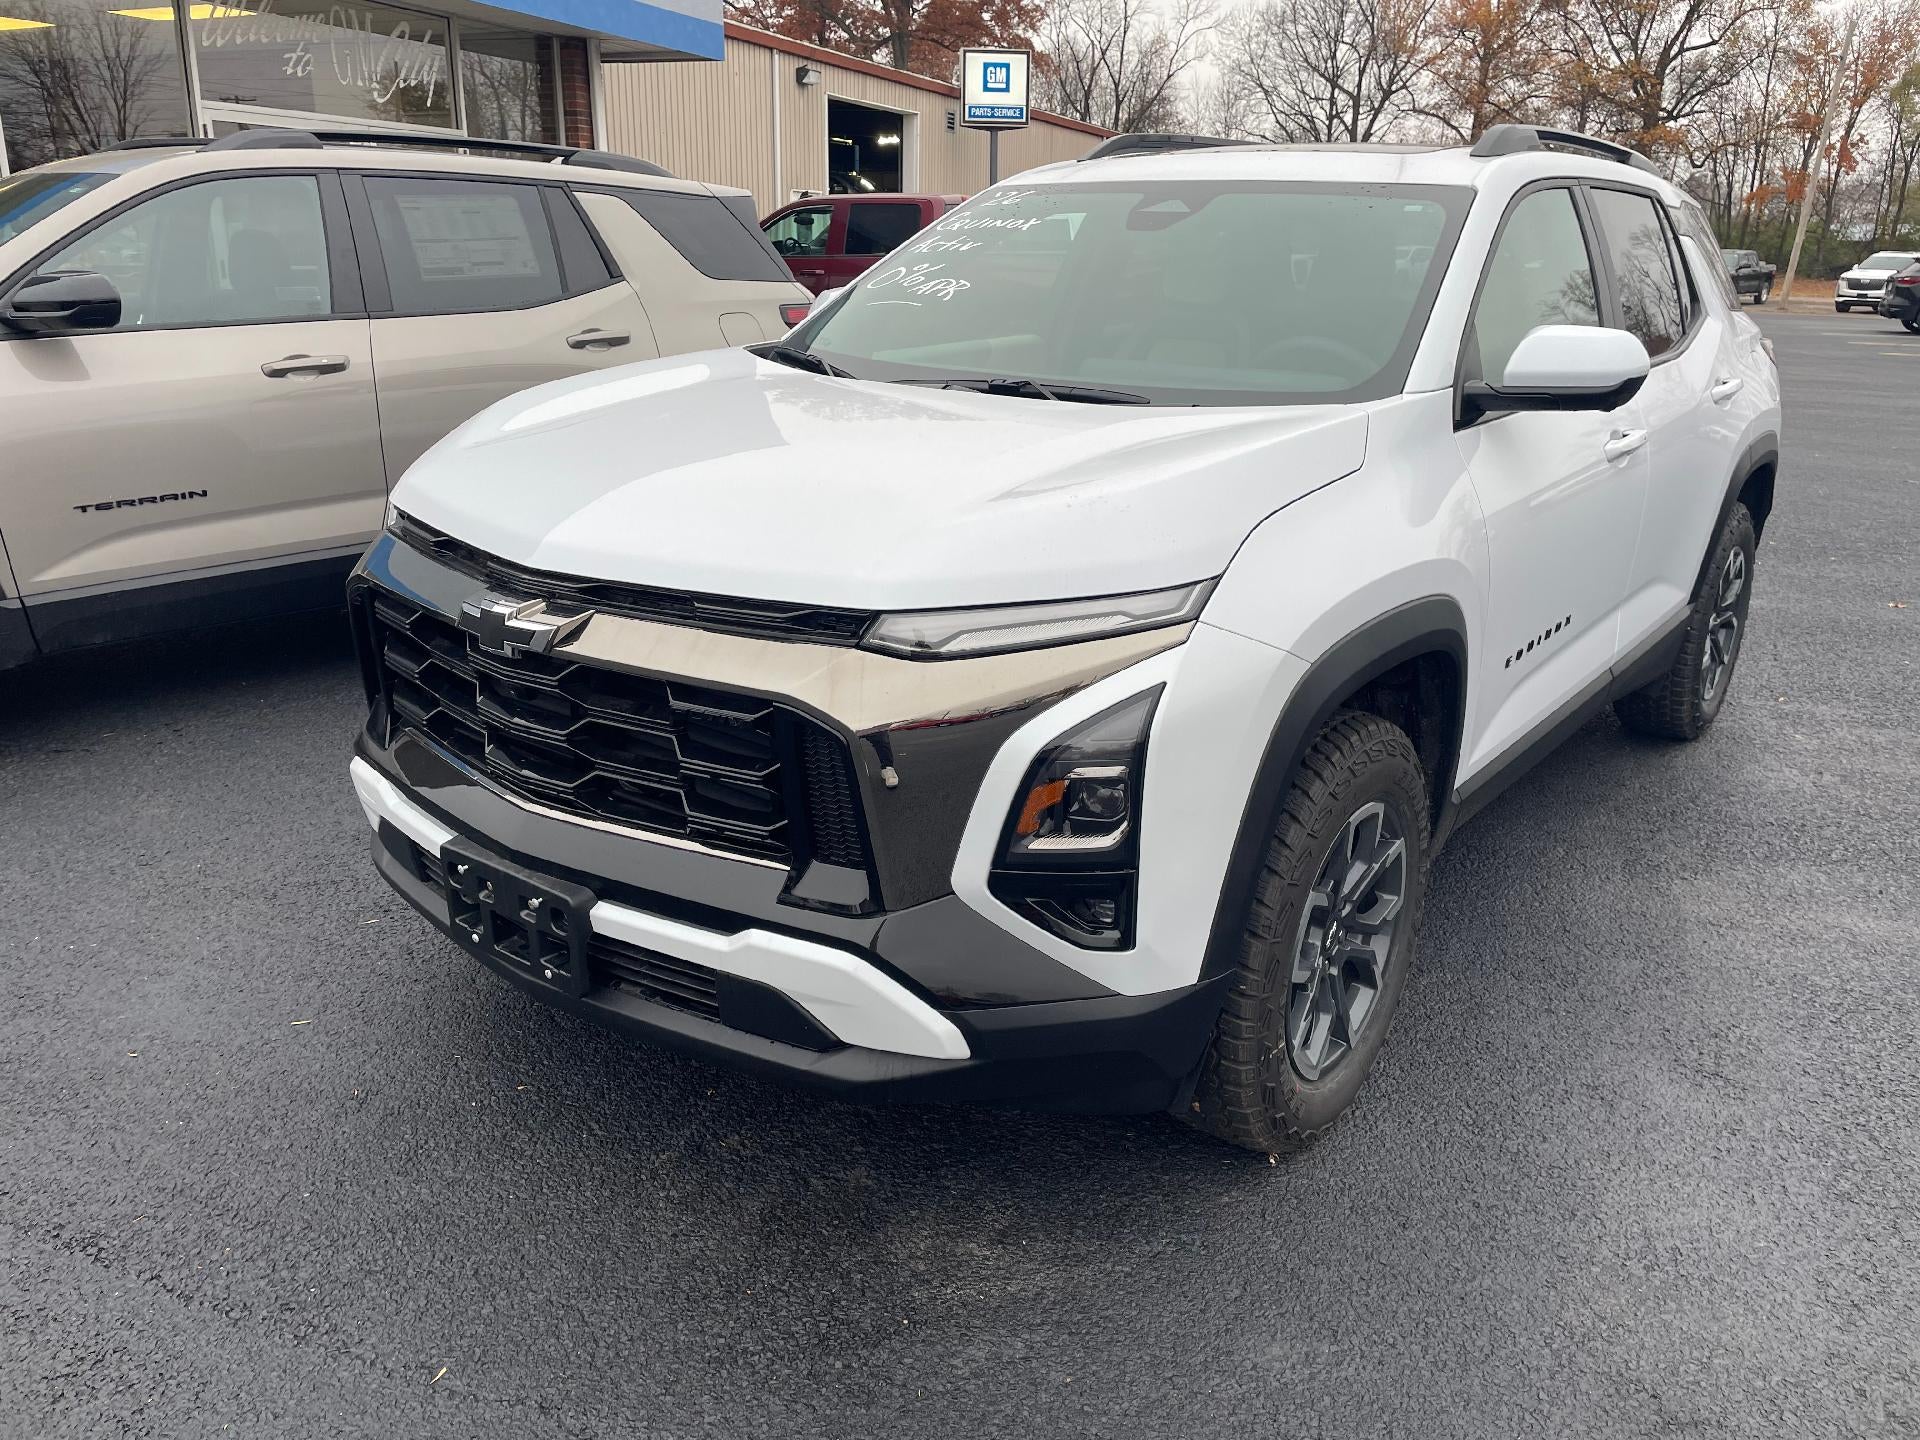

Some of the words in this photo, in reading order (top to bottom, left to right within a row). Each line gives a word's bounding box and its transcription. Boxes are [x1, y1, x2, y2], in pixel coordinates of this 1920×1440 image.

[282, 41, 315, 77] to
[329, 4, 377, 88] GM
[986, 66, 1007, 83] GM
[971, 107, 1021, 117] PARTS-SERVICE
[73, 490, 209, 513] TERRAIN
[1504, 613, 1573, 669] EQUINOX
